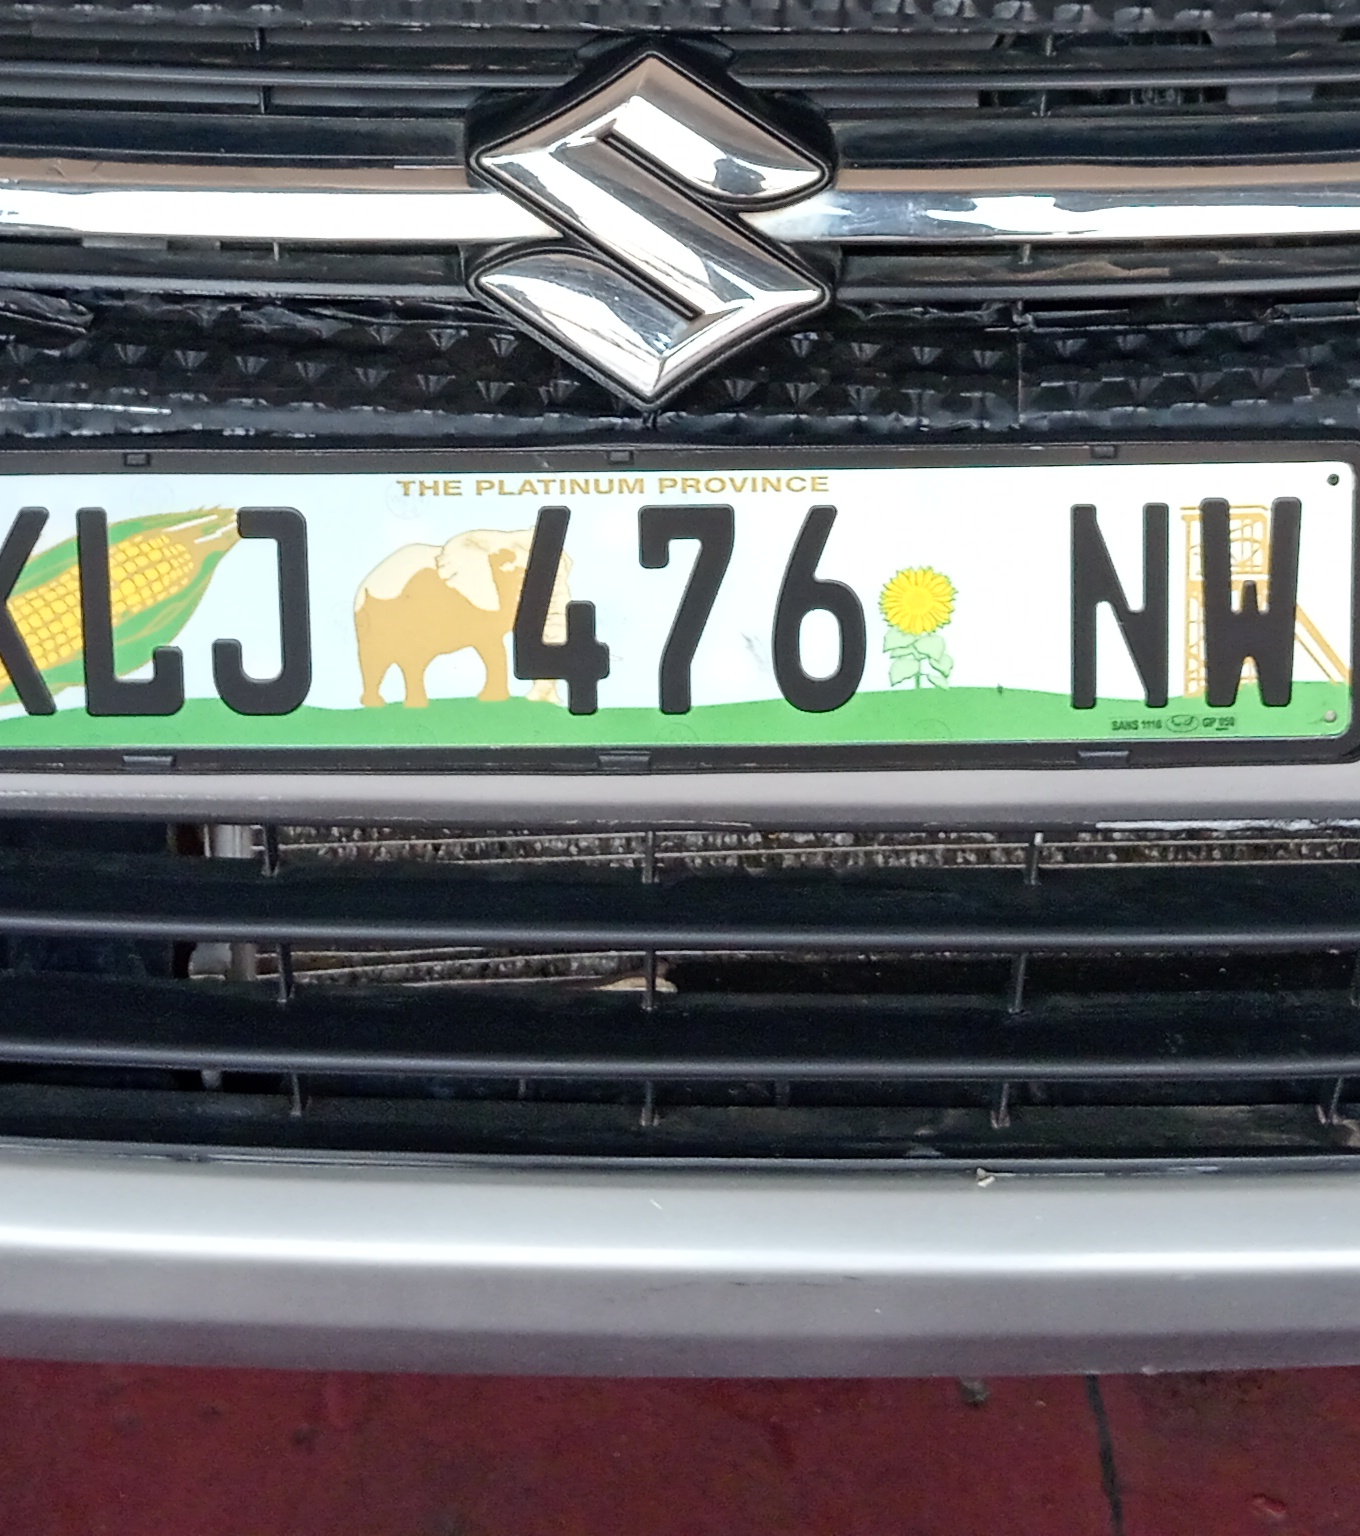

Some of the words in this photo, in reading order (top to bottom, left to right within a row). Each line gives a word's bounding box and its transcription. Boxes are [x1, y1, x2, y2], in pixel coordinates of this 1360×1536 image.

[396, 479, 462, 497] THE
[475, 477, 645, 496] PLATINUM
[658, 475, 830, 494] PROVINCE
[513, 505, 867, 716] 476
[1070, 497, 1302, 709] NW
[1112, 720, 1138, 731] SANS
